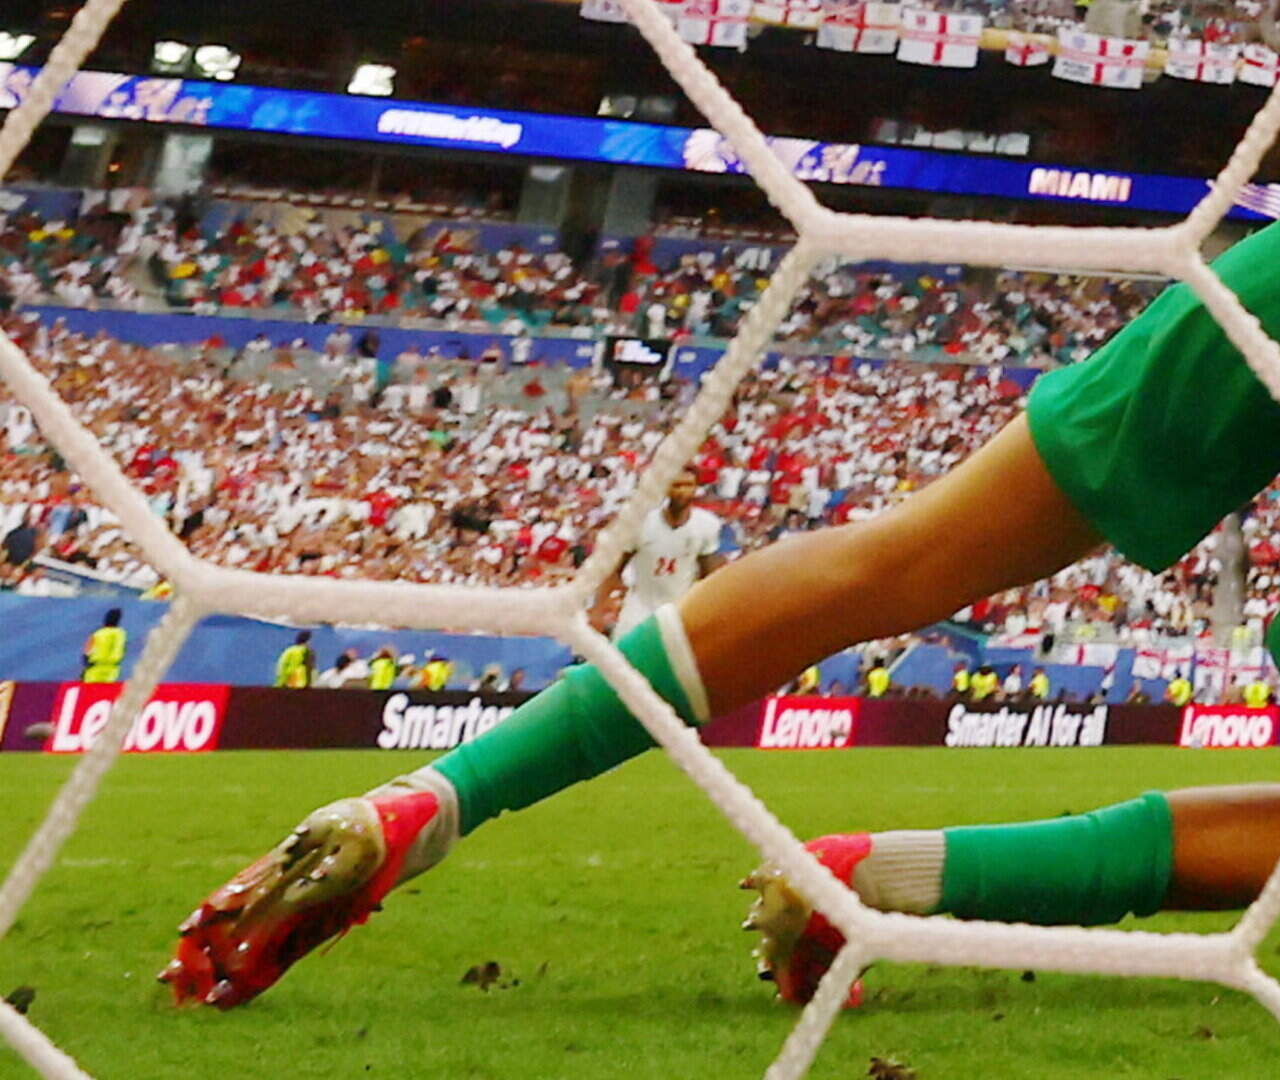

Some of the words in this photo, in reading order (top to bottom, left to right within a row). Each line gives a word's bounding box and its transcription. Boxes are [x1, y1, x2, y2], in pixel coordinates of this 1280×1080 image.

[1029, 169, 1131, 202] MIAMI
[760, 697, 854, 747] Lenovo
[945, 703, 1029, 747] Smarter
[1023, 704, 1053, 747] AI
[1050, 703, 1083, 747] for
[1079, 703, 1109, 747] all
[1181, 706, 1273, 747] Lenovo
